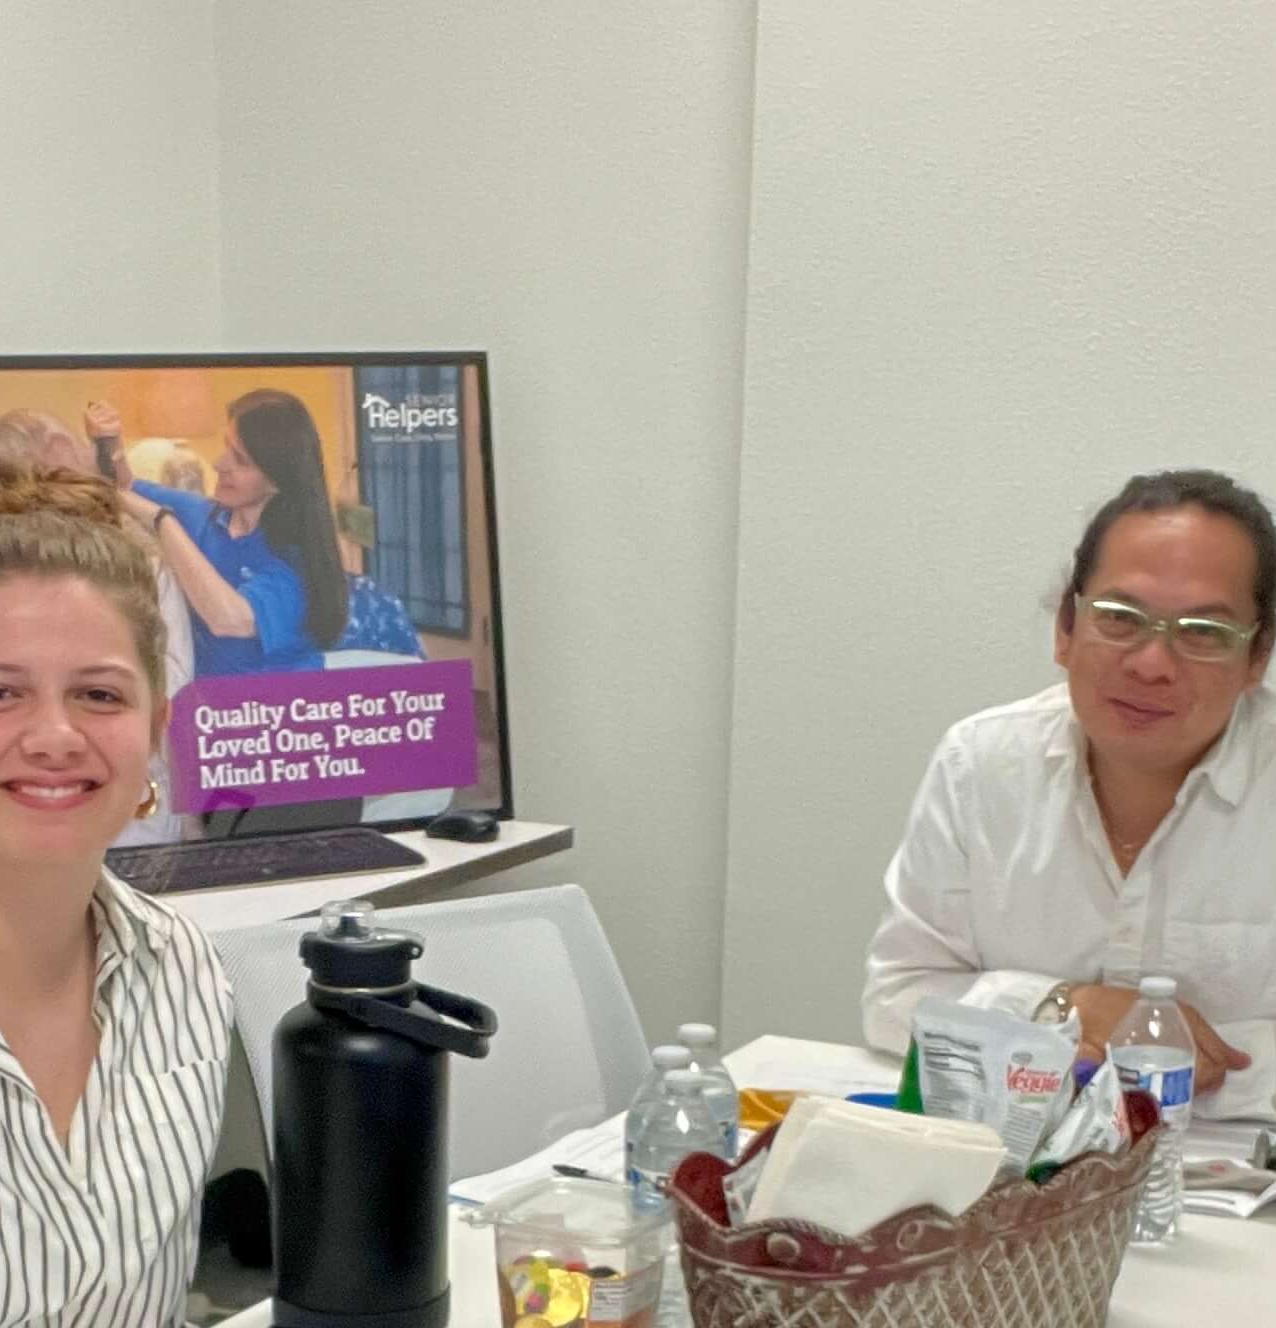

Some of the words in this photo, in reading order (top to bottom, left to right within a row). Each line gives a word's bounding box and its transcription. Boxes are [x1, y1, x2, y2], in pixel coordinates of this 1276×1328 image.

[368, 402, 459, 433] Helpers
[195, 701, 285, 733] Quality
[290, 698, 343, 723] Care
[348, 694, 387, 717] For
[390, 691, 445, 714] Your
[198, 730, 271, 760] Loved
[276, 728, 329, 752] One,
[335, 724, 401, 748] Peace
[407, 717, 436, 740] Of
[200, 761, 266, 789] Mind
[271, 759, 310, 783] For
[315, 755, 365, 778] You.
[1007, 1064, 1062, 1093] Veggie
